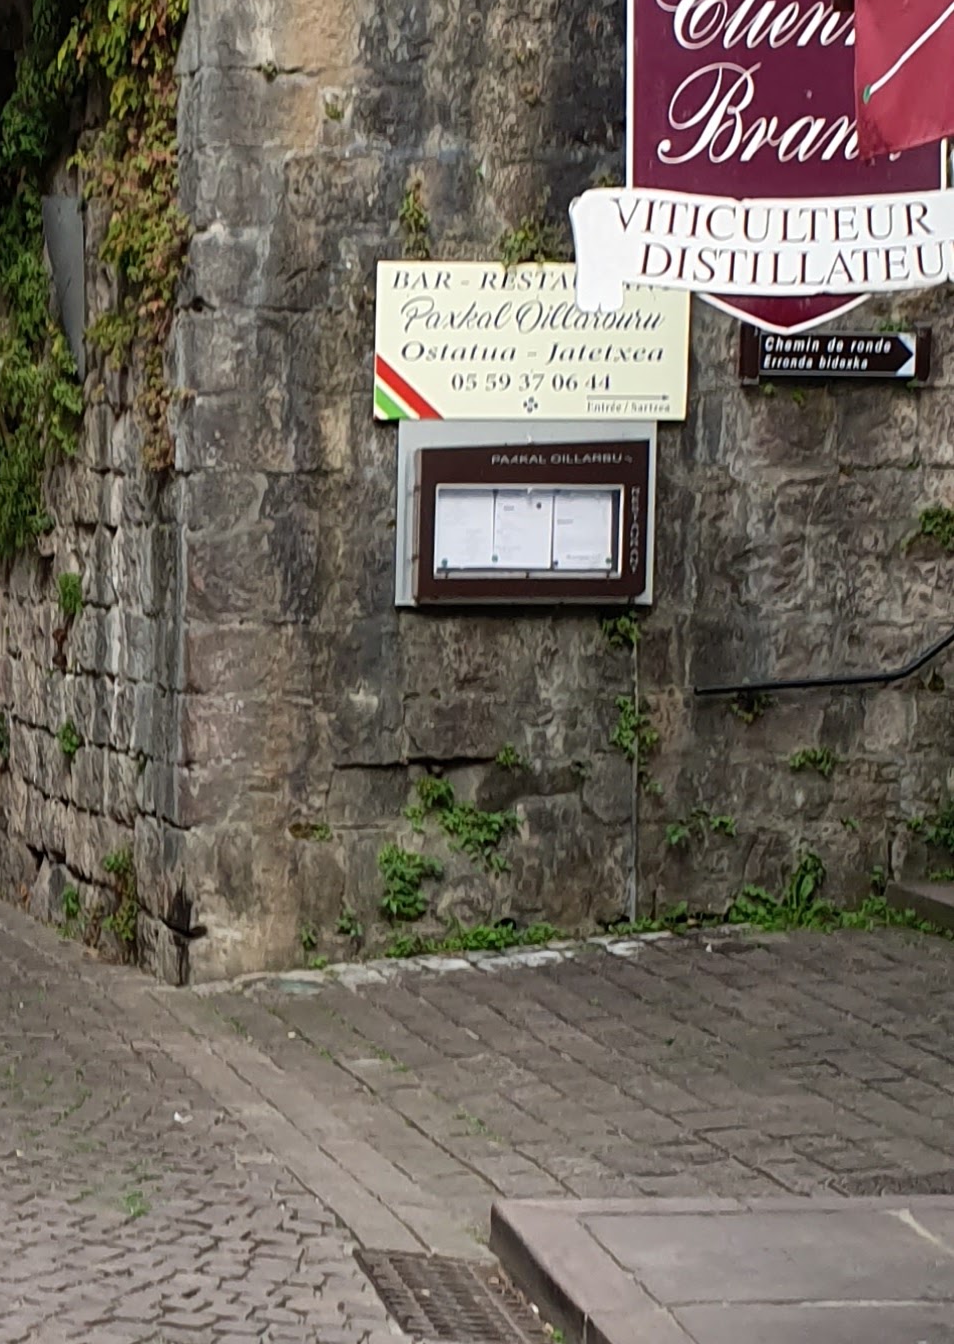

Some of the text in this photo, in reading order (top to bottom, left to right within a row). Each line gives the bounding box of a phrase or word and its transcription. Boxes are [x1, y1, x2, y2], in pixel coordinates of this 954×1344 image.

[657, 62, 901, 164] Bran
[611, 198, 933, 243] VITICULTEUR
[640, 240, 954, 285] DISTILLATEU
[393, 271, 451, 290] BAR
[400, 296, 512, 334] Paxkal
[401, 341, 516, 362] Ostatua
[545, 342, 663, 365] Jatetxea
[764, 336, 892, 353] Chemin de ronde
[451, 374, 610, 392] 05 59 37 06 44
